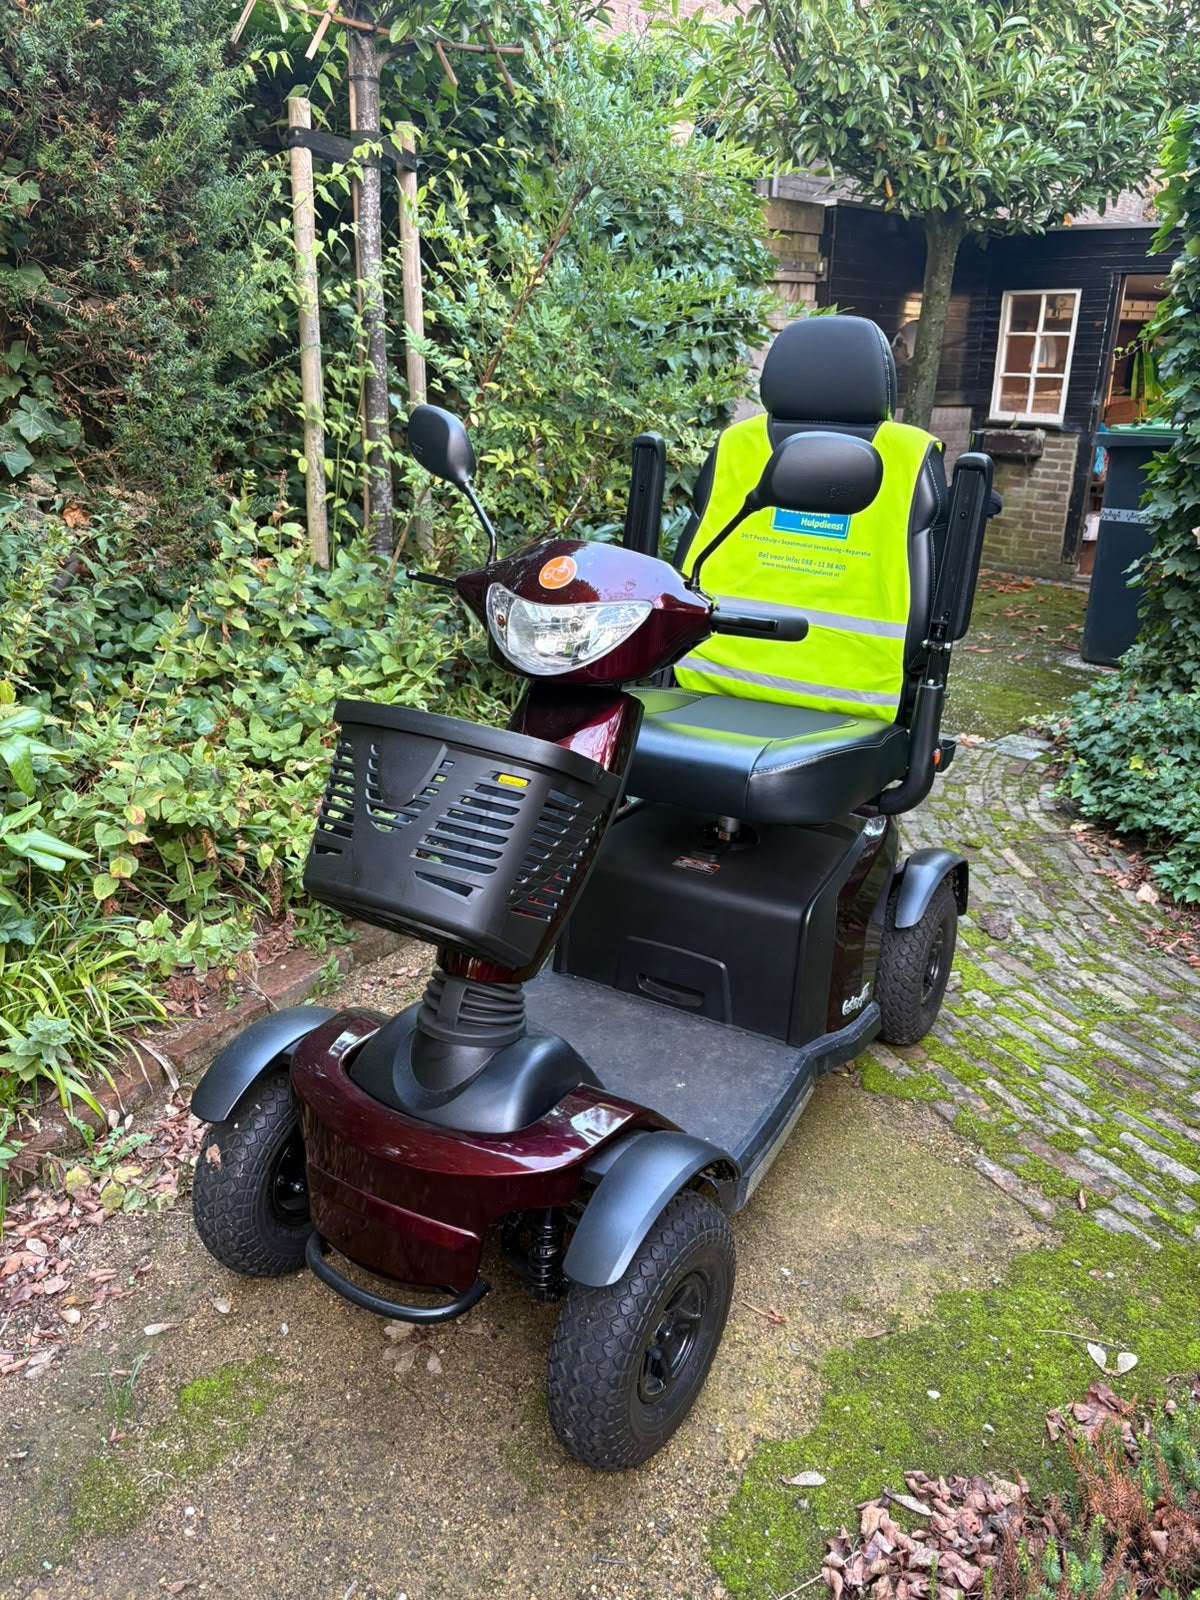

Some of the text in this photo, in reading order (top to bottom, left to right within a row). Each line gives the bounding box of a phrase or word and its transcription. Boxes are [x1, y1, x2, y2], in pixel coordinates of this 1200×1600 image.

[801, 517, 844, 531] Hulpdienst
[753, 534, 777, 544] Pechhulp
[781, 539, 813, 549] Scootmobiel
[845, 549, 871, 557] Reparatie
[757, 551, 769, 559] Bel
[785, 555, 800, 564] info:
